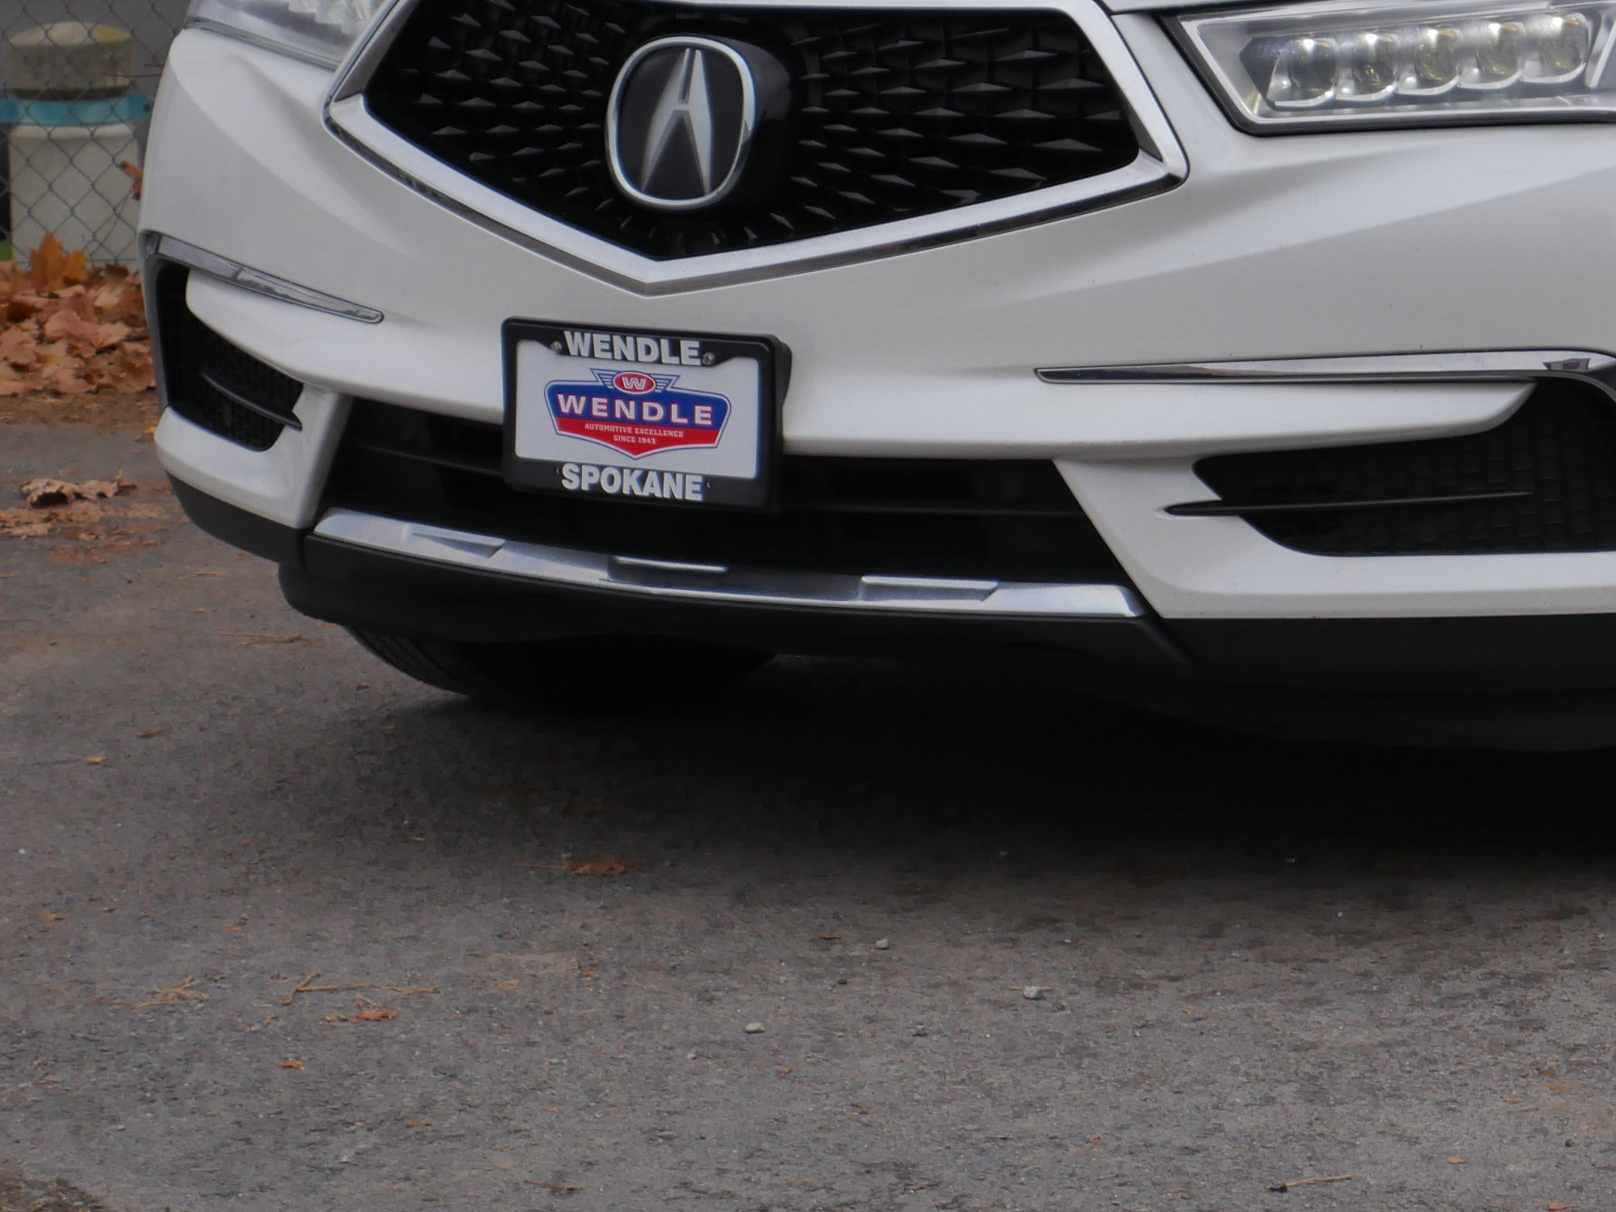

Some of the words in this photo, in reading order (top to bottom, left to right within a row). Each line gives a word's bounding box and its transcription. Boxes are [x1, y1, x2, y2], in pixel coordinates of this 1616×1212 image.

[563, 331, 701, 366] WENDLE
[557, 394, 713, 425] WENDLE
[584, 423, 633, 434] AUTOMOTIVE
[634, 427, 684, 438] EXCELLENCE
[613, 434, 636, 443] SINCE
[638, 437, 656, 445] 1943
[561, 463, 703, 502] SPOKANE
